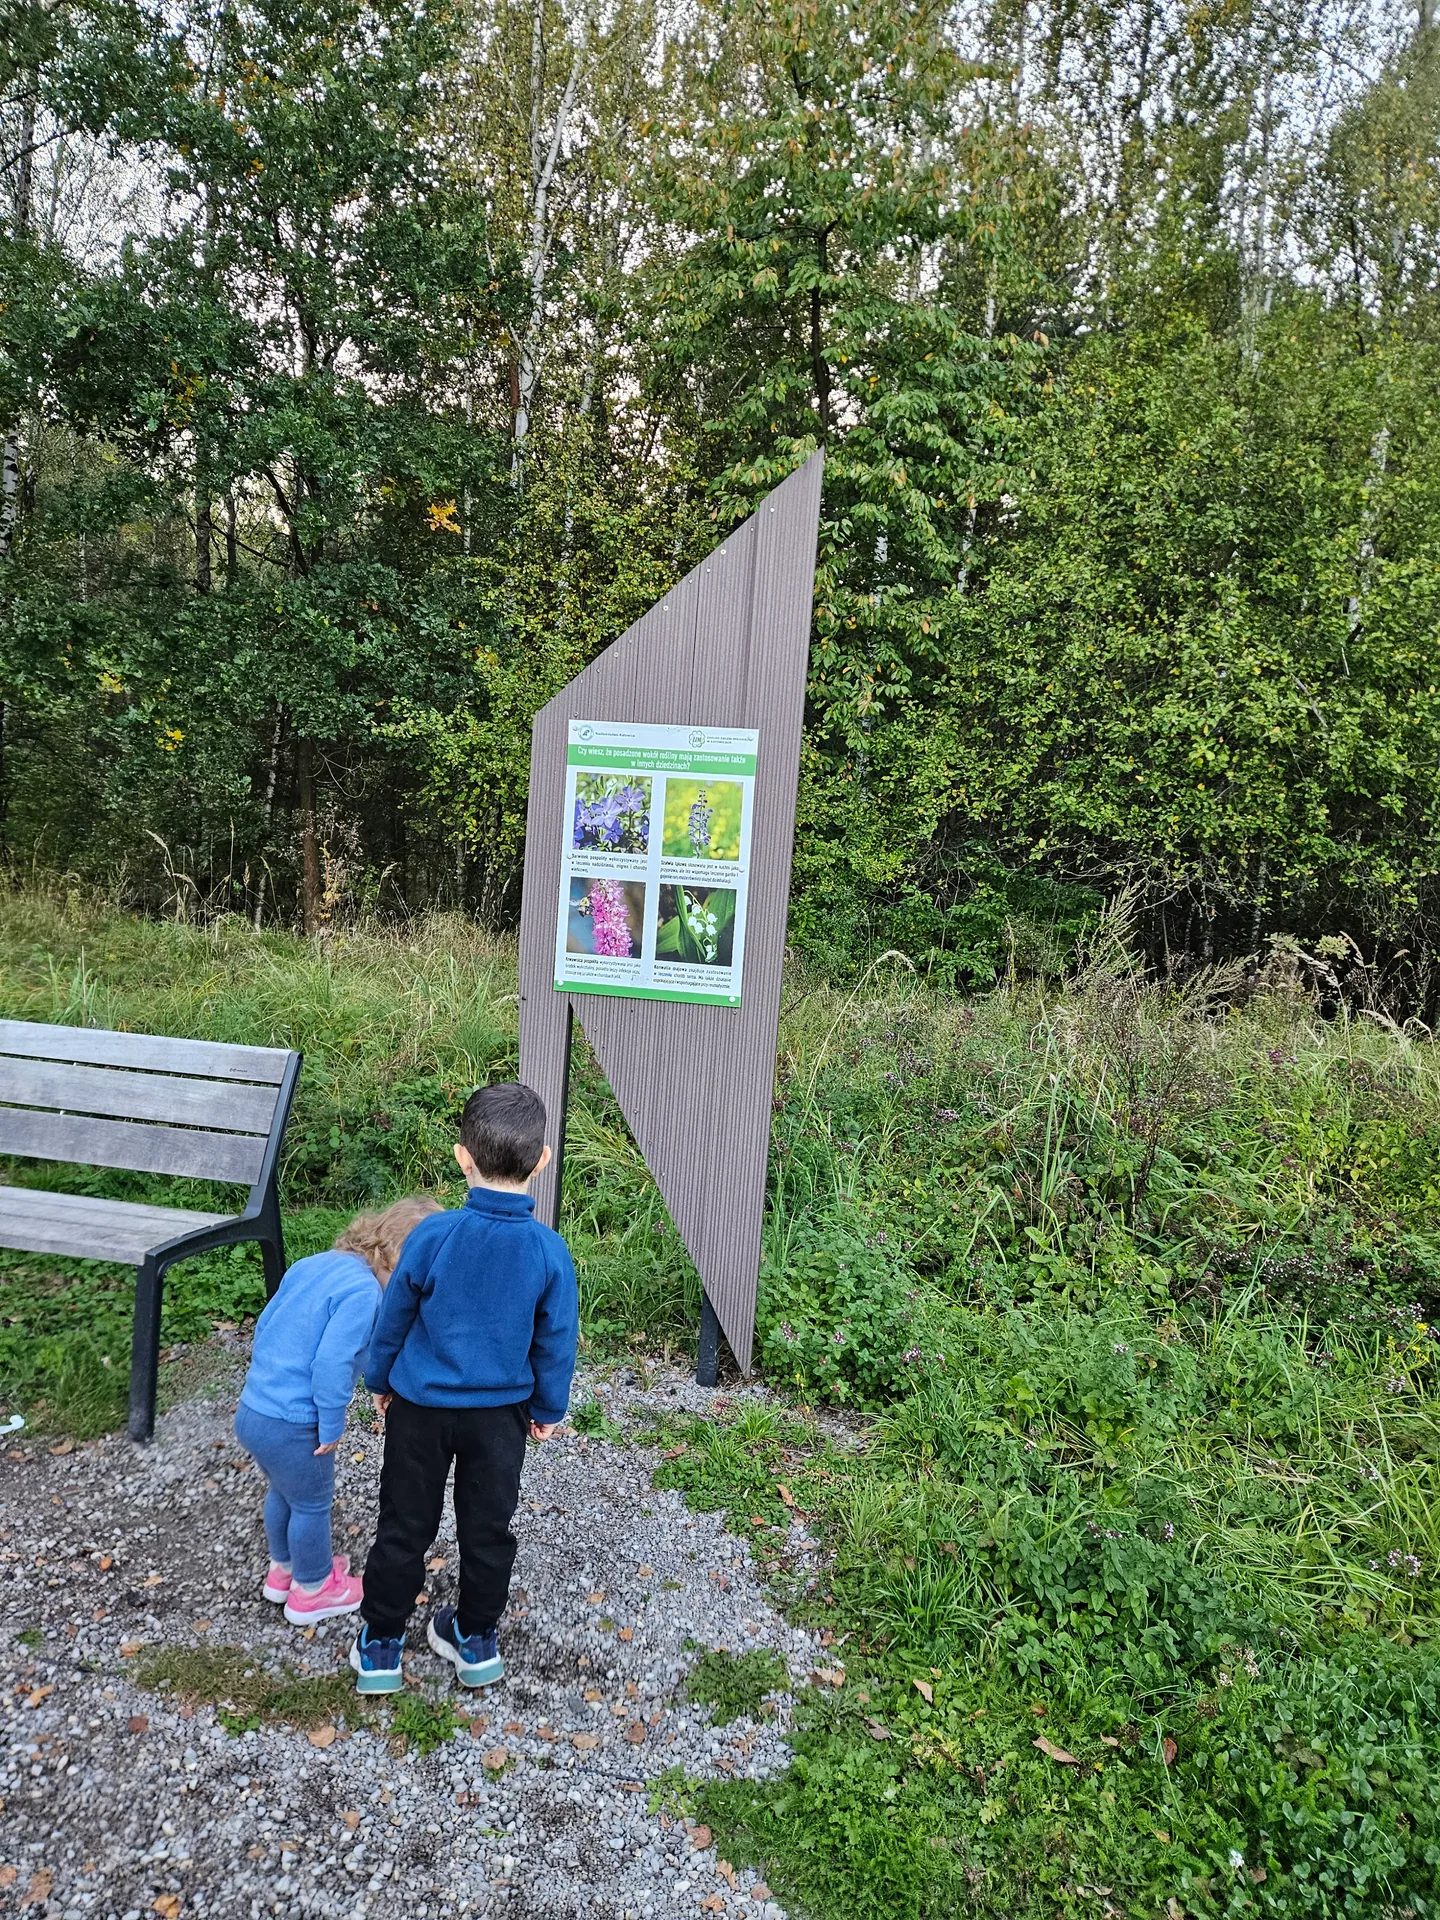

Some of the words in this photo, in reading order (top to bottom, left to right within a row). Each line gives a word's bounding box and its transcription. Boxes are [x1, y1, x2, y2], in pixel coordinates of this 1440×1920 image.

[578, 746, 587, 756] Czy
[588, 747, 604, 756] wiesz,
[613, 749, 641, 757] posadzone
[660, 751, 677, 760] rośliny
[679, 753, 692, 762] mają
[693, 754, 730, 763] zastosowanie
[731, 756, 746, 764] także
[637, 760, 655, 768] innych
[656, 761, 690, 770] dziedzinach?
